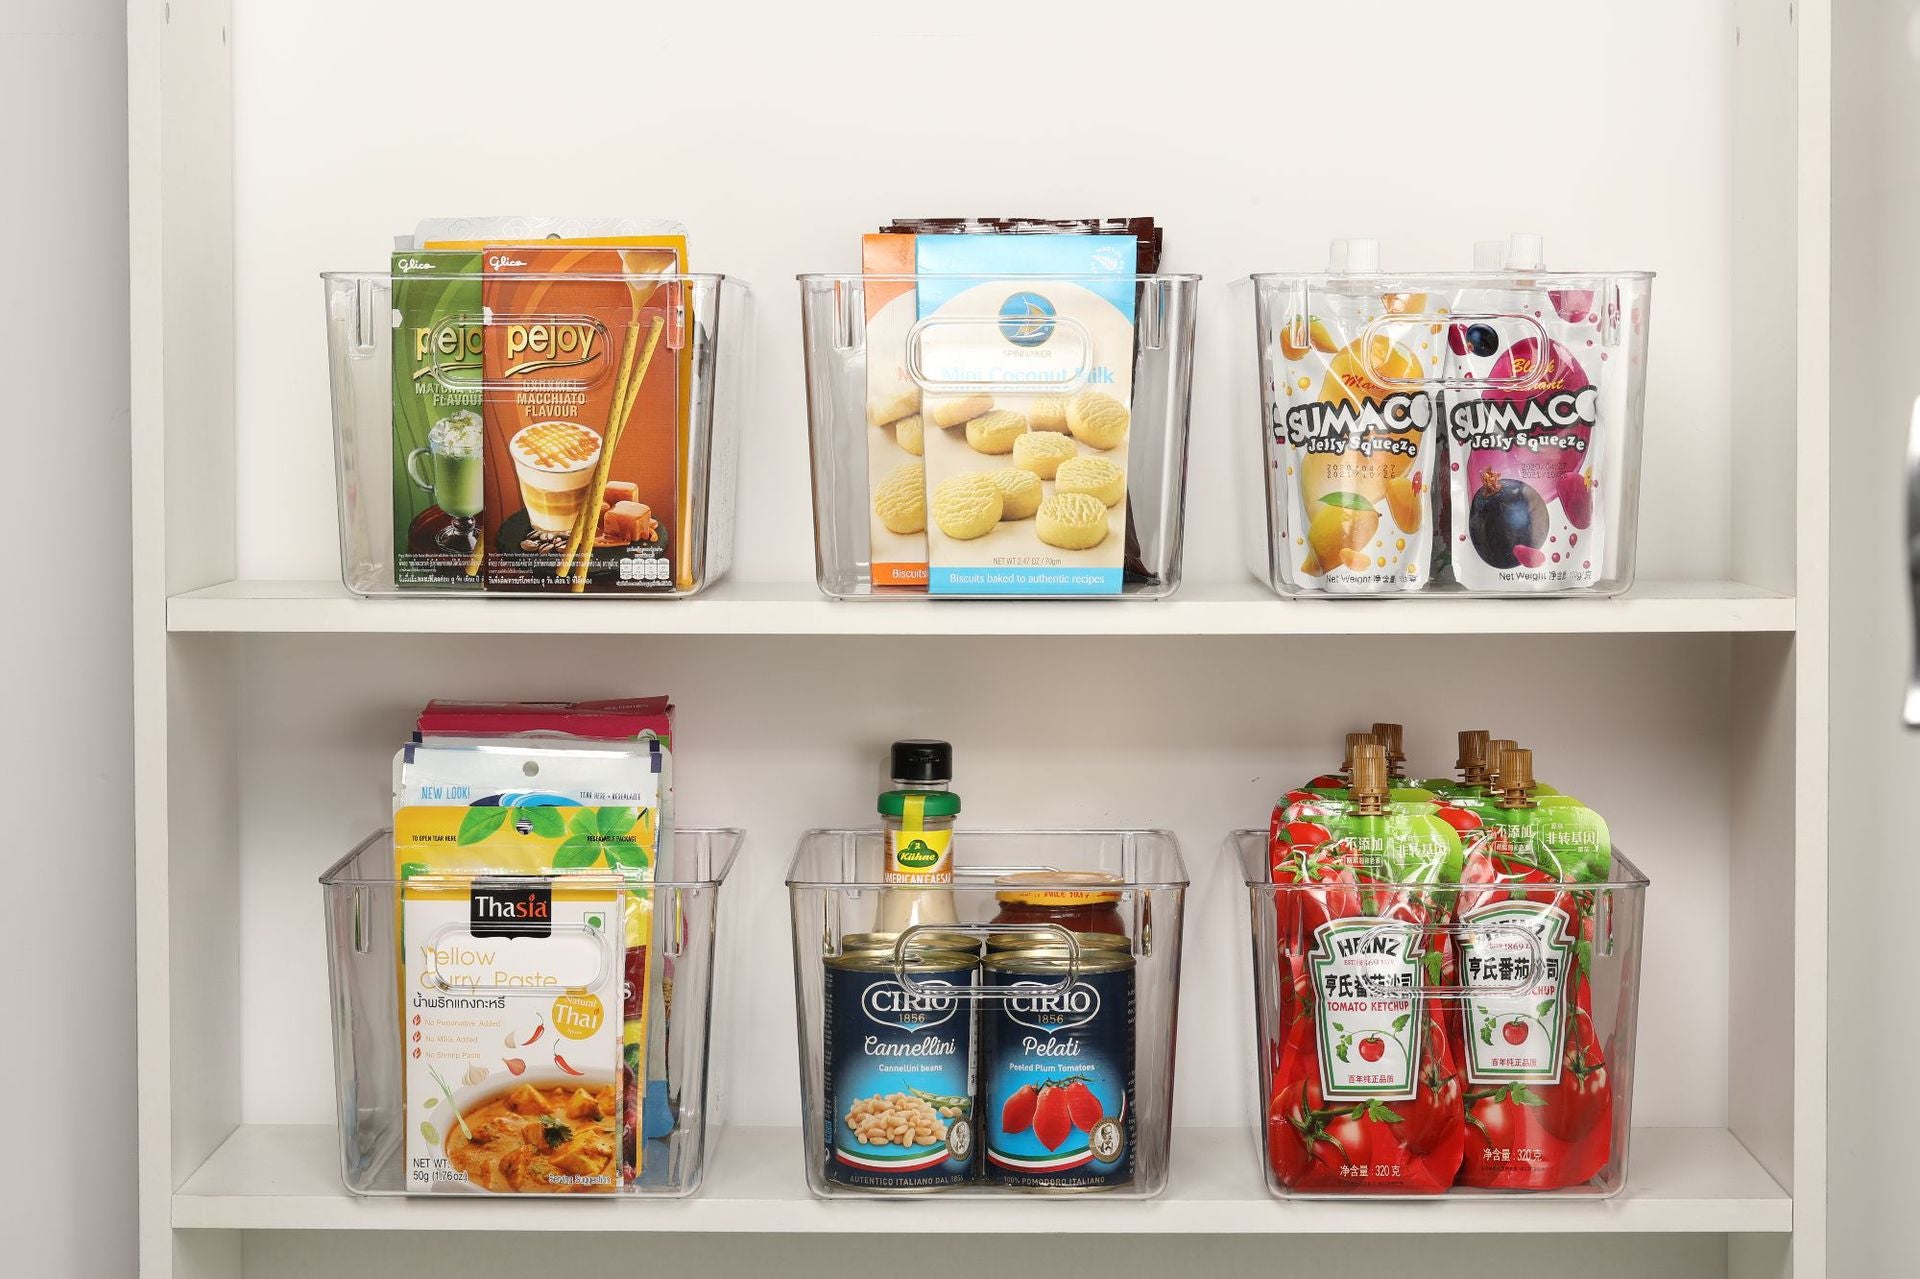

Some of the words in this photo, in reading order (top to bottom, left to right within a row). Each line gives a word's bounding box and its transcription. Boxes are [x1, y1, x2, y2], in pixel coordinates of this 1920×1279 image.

[398, 258, 436, 273] Glico
[489, 255, 527, 271] Glico
[506, 321, 596, 360] pejoy
[517, 393, 587, 405] MACCHIATO
[525, 405, 579, 417] FLAVOUR
[1288, 393, 1431, 443] SUMACO
[1454, 389, 1598, 439] SUMACO
[1308, 437, 1347, 452] Jelly
[1350, 436, 1417, 454] Squeeze
[1472, 435, 1513, 450] Jelly
[1516, 433, 1585, 451] Squeeze
[892, 568, 927, 579] Biscuits
[950, 573, 984, 583] Biscuits
[987, 573, 1015, 584] baked
[1016, 574, 1026, 584] to
[1028, 573, 1070, 584] authentic
[1072, 575, 1104, 585] recipes
[1499, 572, 1514, 580] Net
[1515, 571, 1547, 581] Weight
[421, 786, 442, 800] NEW
[446, 786, 470, 800] LOOK!
[1546, 831, 1597, 845] 非转基因
[900, 852, 936, 861] Kühne
[475, 894, 547, 918] Thasia
[1468, 956, 1559, 981] 亨氏番茄司
[871, 990, 950, 1012] CIRIO
[1012, 991, 1091, 1012] CIRIO
[1327, 1001, 1367, 1011] TOMATO
[1371, 1001, 1409, 1011] KETCHUP
[556, 1004, 598, 1029] Thai
[899, 1013, 925, 1023] 1856
[1037, 1014, 1064, 1024] 1856
[864, 1035, 956, 1057] Cannellini
[1022, 1036, 1081, 1057] Pelati
[878, 1063, 920, 1072] Cannellini
[920, 1063, 943, 1072] beans
[1009, 1062, 1034, 1072] Peeled
[1035, 1063, 1056, 1072] Plum
[1057, 1063, 1095, 1072] Tomatoes
[413, 1158, 430, 1168] NET
[433, 1158, 450, 1168] WT.
[413, 1171, 429, 1183] 50g
[849, 1175, 893, 1186] AUTENTICO
[895, 1177, 933, 1186] ITALIANO
[935, 1176, 949, 1184] DAL
[1004, 1175, 1020, 1183] 100%
[1021, 1177, 1067, 1186] POMODORO
[1069, 1176, 1105, 1186] ITALIANO
